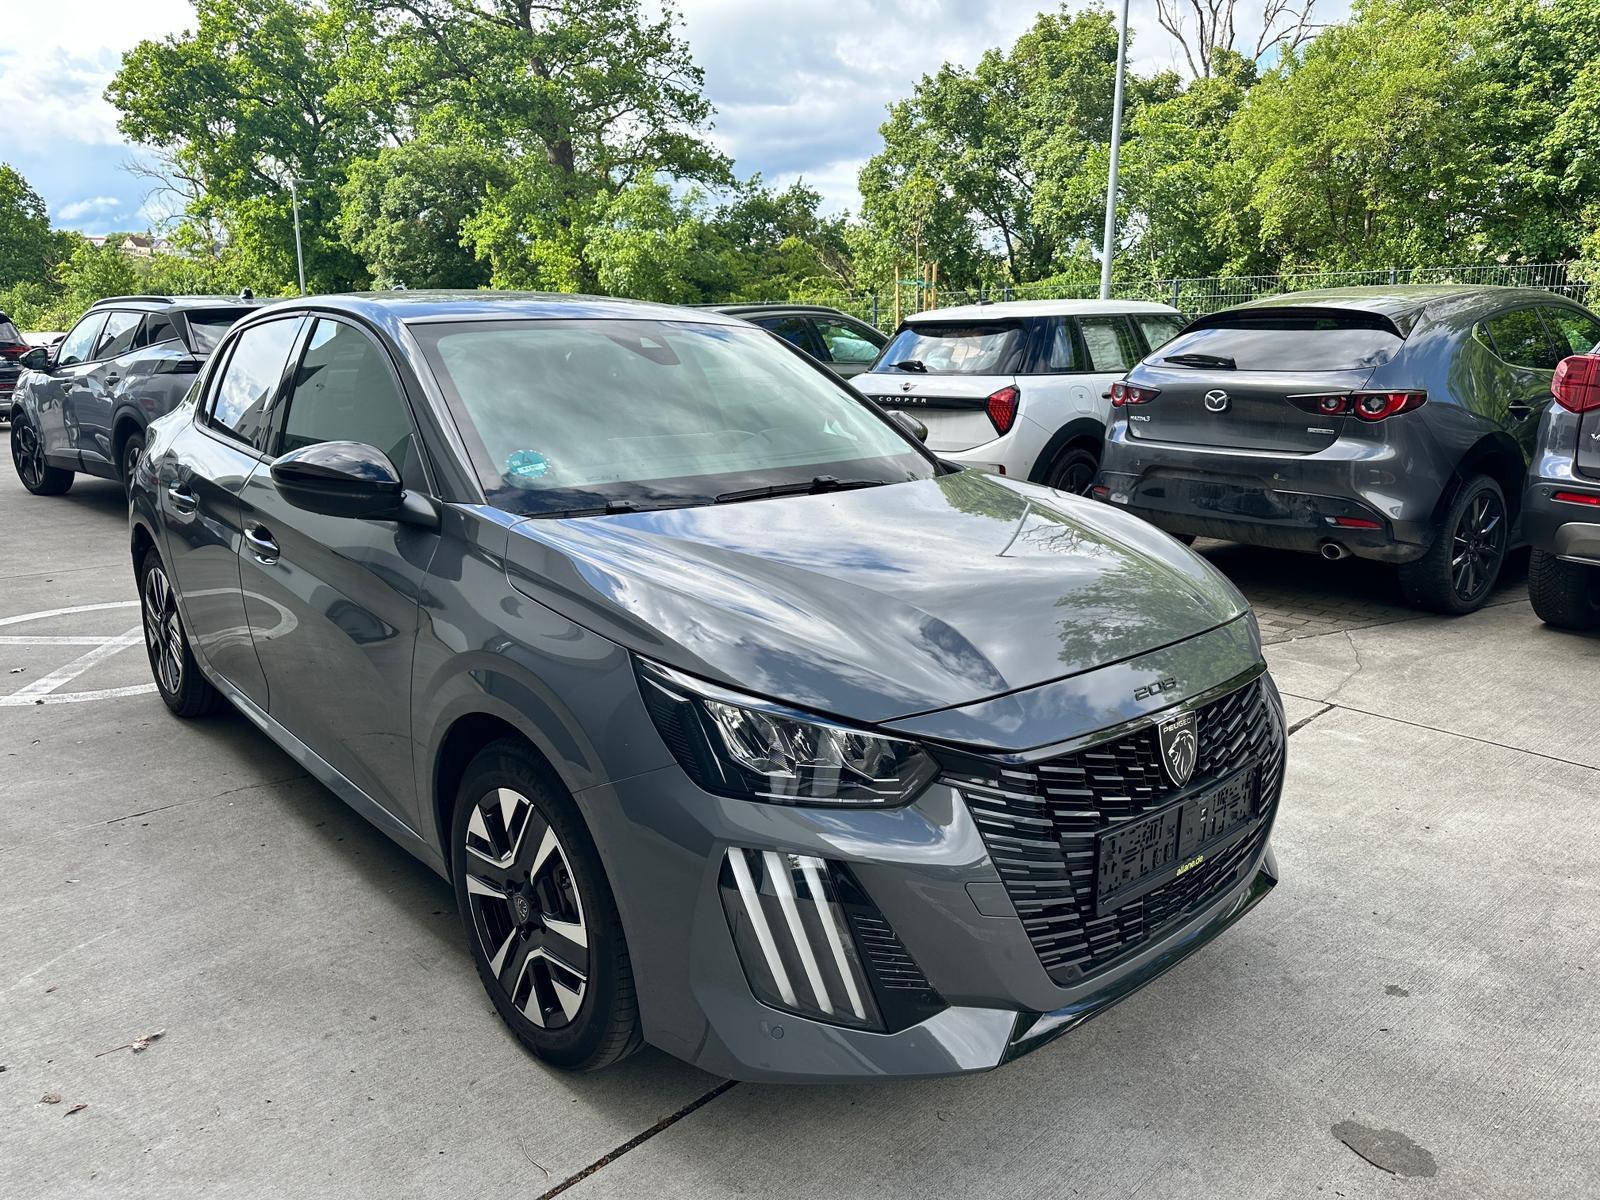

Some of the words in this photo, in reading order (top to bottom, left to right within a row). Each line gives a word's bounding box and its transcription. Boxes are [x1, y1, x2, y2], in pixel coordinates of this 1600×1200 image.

[878, 396, 928, 404] COOPER
[1133, 677, 1177, 702] 208
[1162, 716, 1194, 734] PEUGEOT
